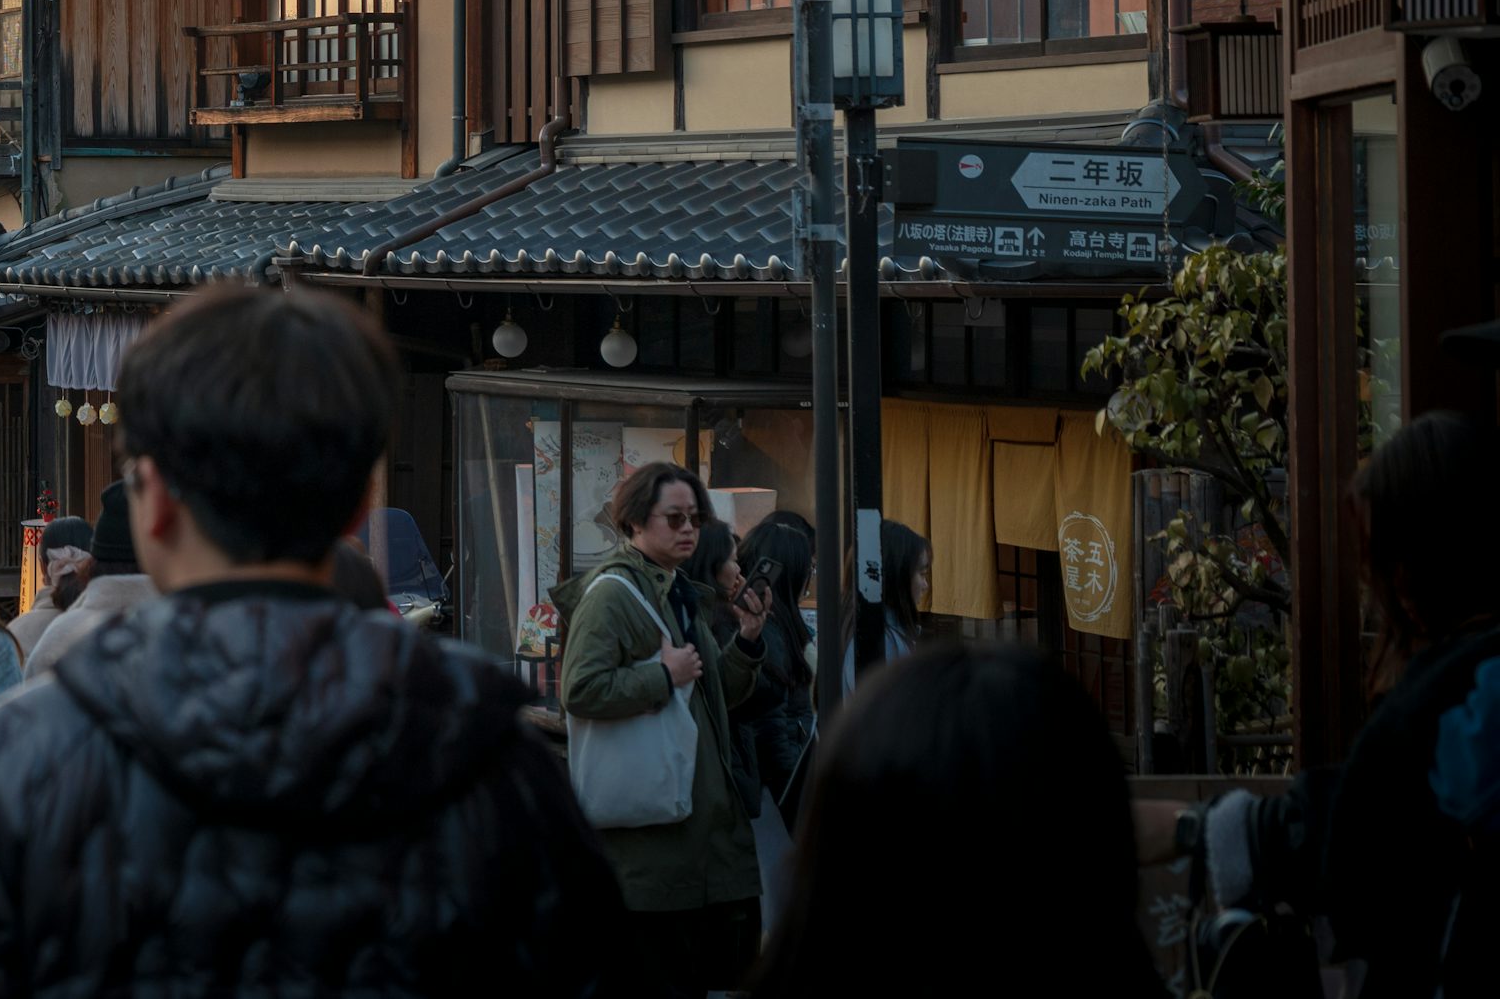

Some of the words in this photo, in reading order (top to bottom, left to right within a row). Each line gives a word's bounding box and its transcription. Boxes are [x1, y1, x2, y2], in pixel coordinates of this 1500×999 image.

[1049, 159, 1144, 187] 二年坂
[1038, 193, 1117, 208] Ninen-zaka
[1120, 196, 1152, 208] Path
[898, 223, 994, 243] 八坂の塔(法観寺)
[1069, 230, 1125, 249] 高台寺
[929, 243, 959, 252] Yasaka
[961, 245, 993, 254] Pagoda
[1063, 249, 1092, 259] Kodaiji
[1095, 250, 1125, 260] Temple
[1063, 537, 1085, 591] 茶屋
[1084, 541, 1105, 595] 五木
